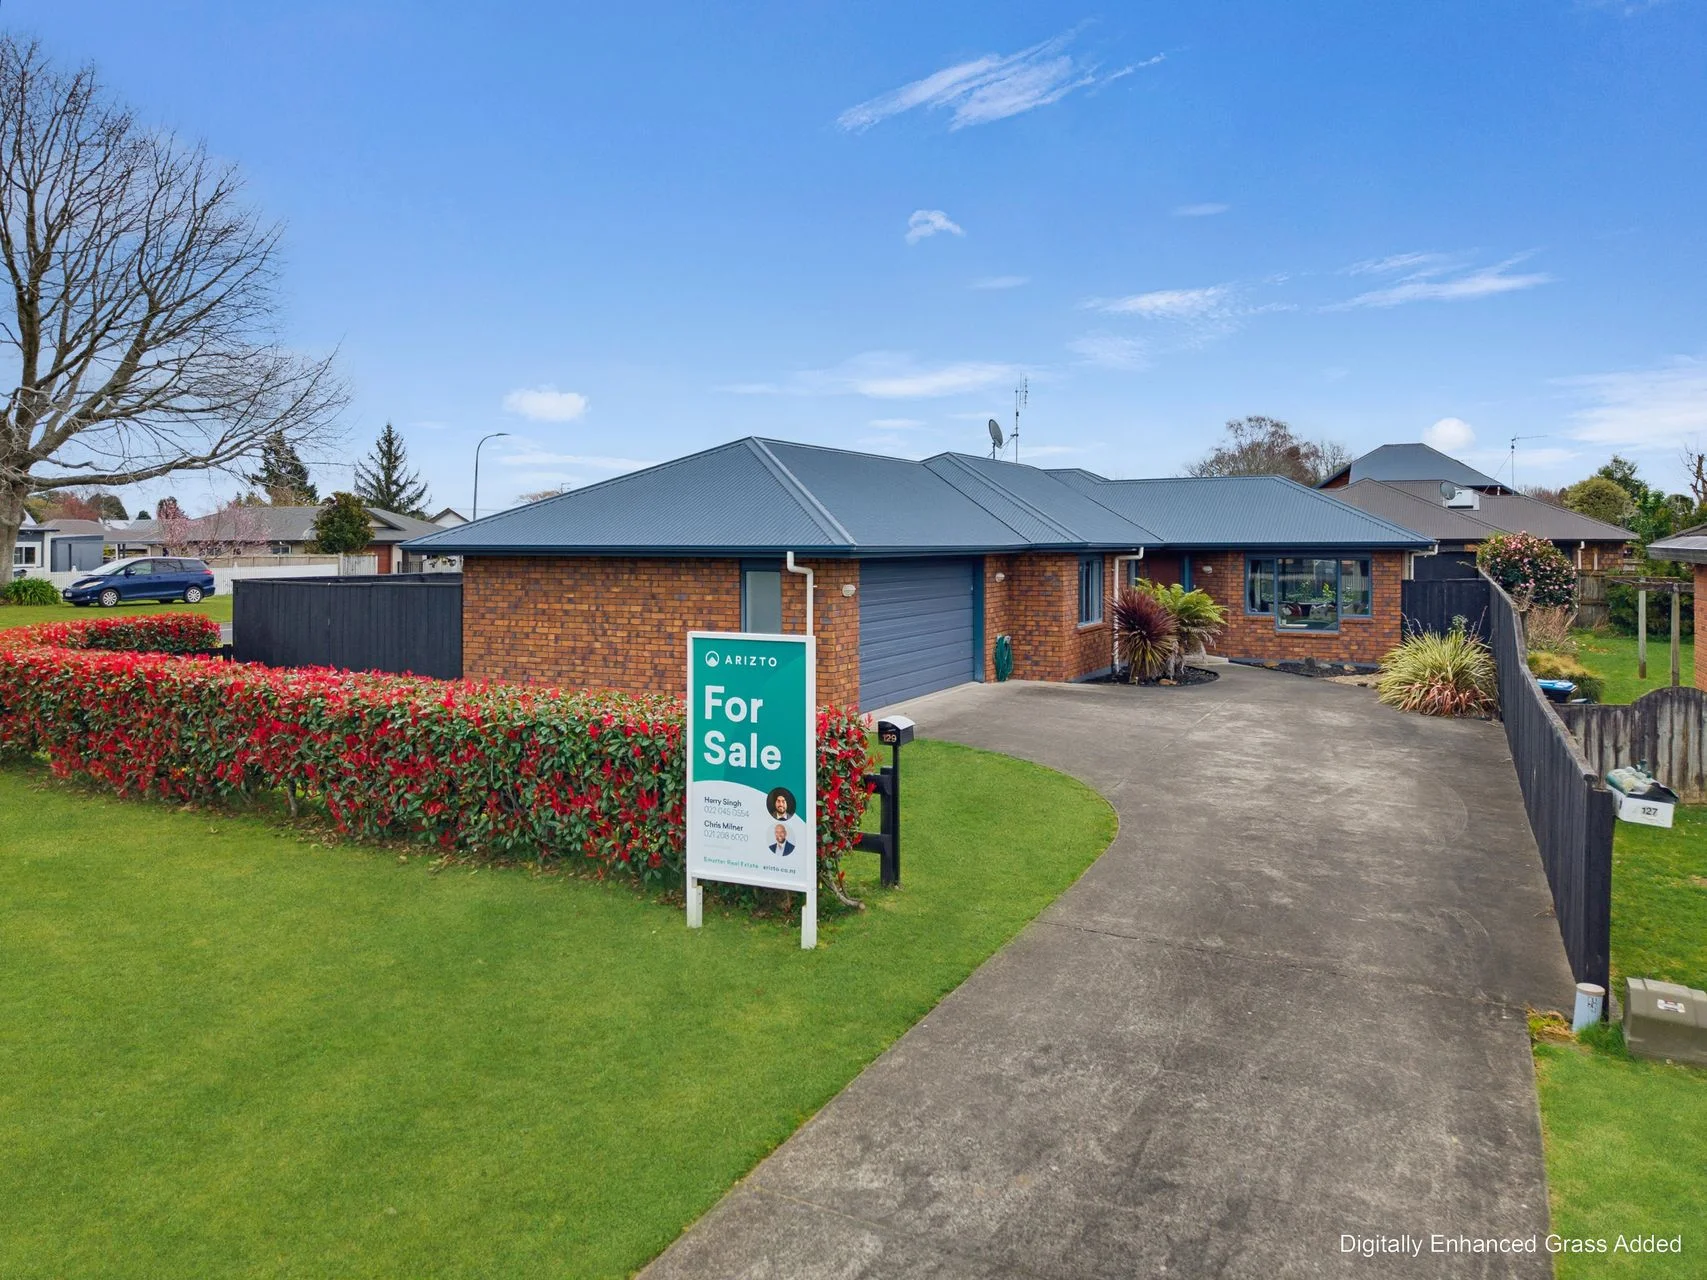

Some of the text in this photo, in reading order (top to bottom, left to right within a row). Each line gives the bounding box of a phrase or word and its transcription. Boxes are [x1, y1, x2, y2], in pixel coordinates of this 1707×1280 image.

[725, 655, 777, 667] ARIZTO
[704, 685, 764, 724] For
[882, 733, 897, 743] 129
[703, 730, 782, 771] Sale
[704, 796, 742, 808] Harry Singh
[704, 805, 717, 814] 022
[1641, 806, 1658, 817] 127
[704, 820, 743, 831] Chris Milner
